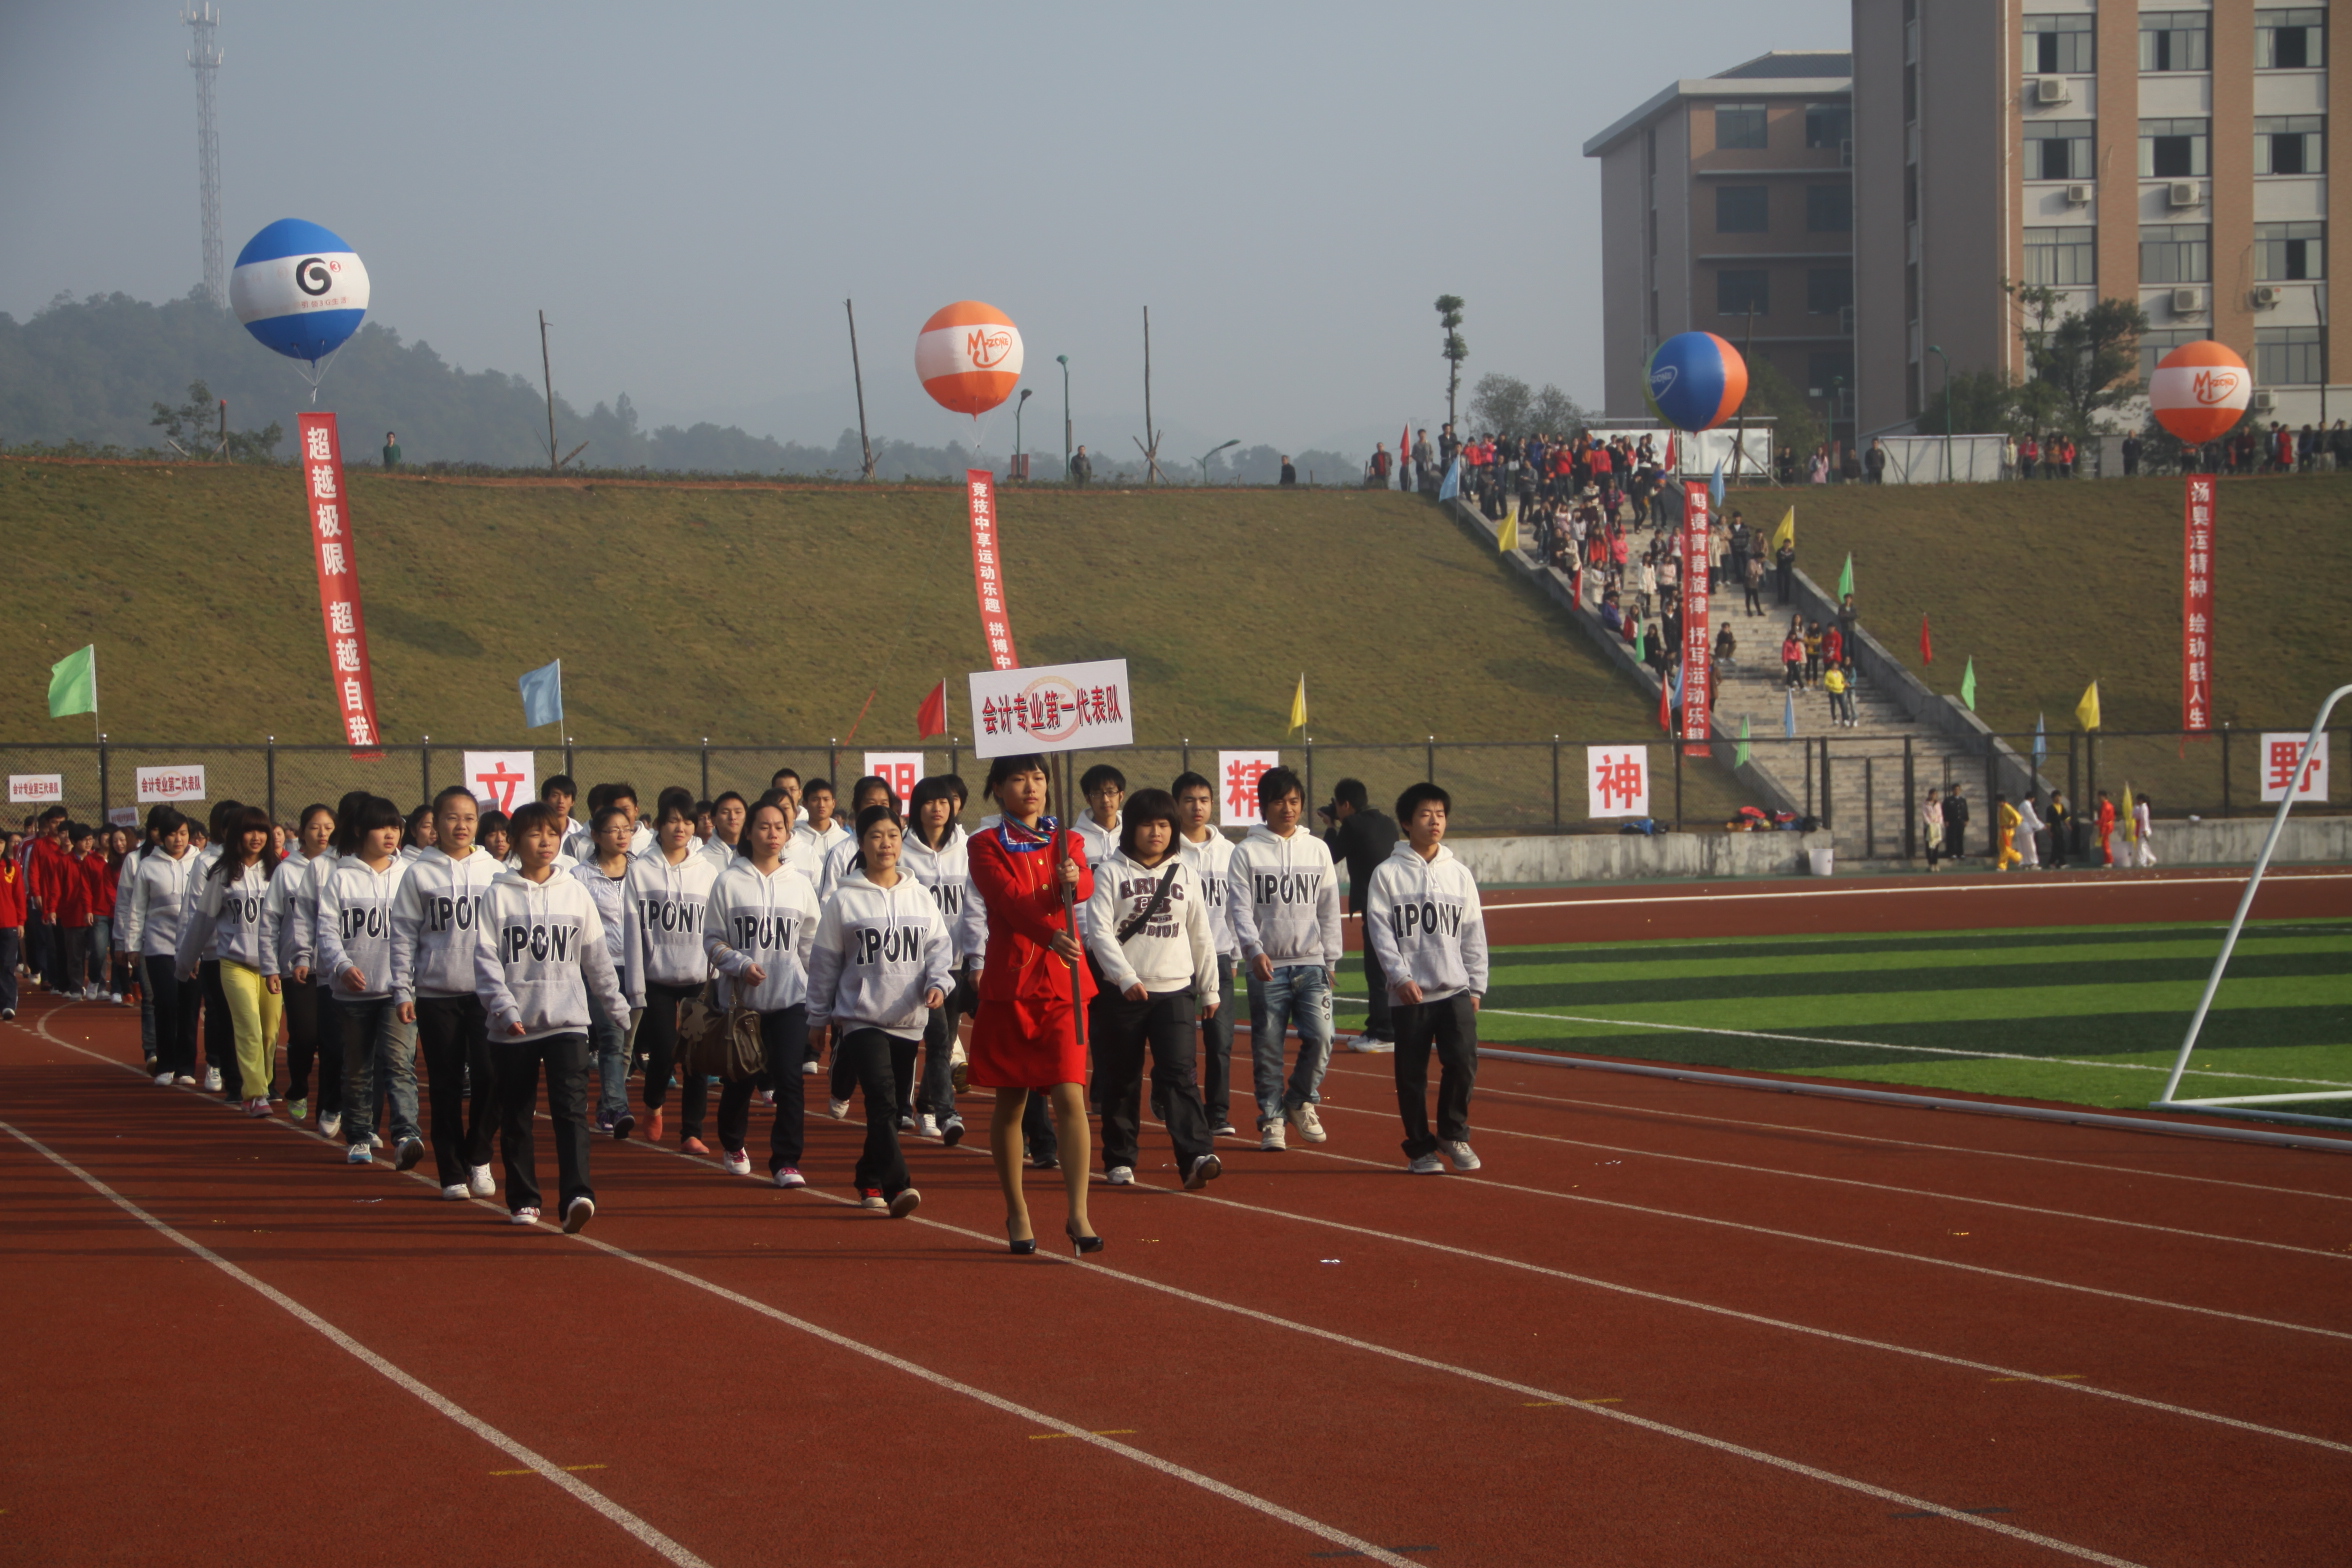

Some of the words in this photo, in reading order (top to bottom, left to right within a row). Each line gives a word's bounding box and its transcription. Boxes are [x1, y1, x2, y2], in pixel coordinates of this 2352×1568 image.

[2189, 482, 2210, 598] 扬奥运精神
[307, 427, 347, 576] 超越极限
[330, 601, 373, 745] 超越自我
[972, 482, 1001, 613] 竞技中享运动乐趣
[989, 622, 1011, 670] 拼搏中
[2189, 613, 2206, 728] 绘动感人生
[982, 684, 1123, 735] 会计专业第一代表队
[13, 782, 59, 796] 会计专业第三代表队
[141, 775, 202, 793] 会计专业第二代表队
[1226, 760, 1271, 818] 精
[1596, 754, 1642, 809] 神
[2268, 741, 2321, 793] 野
[1254, 872, 1321, 906] IPONY
[1394, 901, 1463, 939] IPONY
